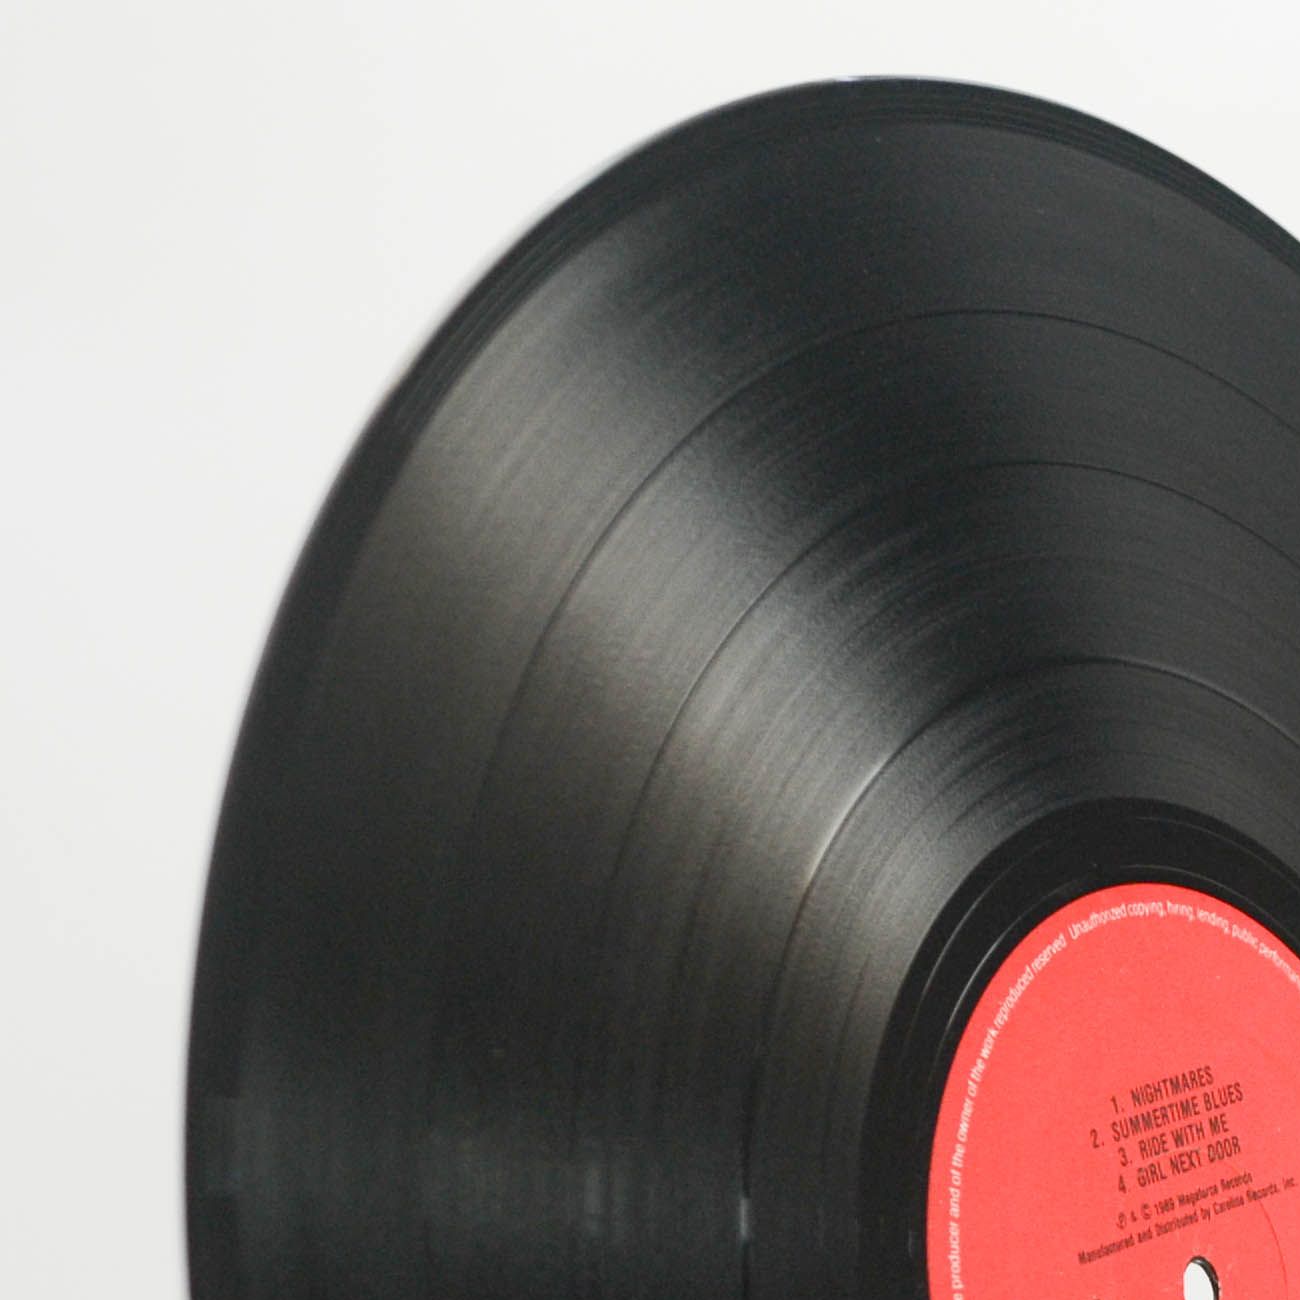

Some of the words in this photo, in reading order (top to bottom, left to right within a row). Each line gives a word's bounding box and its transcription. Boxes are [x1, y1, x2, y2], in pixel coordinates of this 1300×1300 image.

[1068, 902, 1127, 940] Unauthorized
[1031, 933, 1067, 973] reserved
[994, 964, 1034, 1029] reproduced
[981, 1027, 998, 1059] work
[967, 1079, 977, 1097] of
[970, 1059, 985, 1082] the
[1111, 1095, 1125, 1114] 1.
[1131, 1066, 1214, 1107] NIGHTMARES
[957, 1098, 974, 1142] owner
[1090, 1129, 1104, 1148] 2.
[1111, 1096, 1200, 1142] SUMMERTIME
[1203, 1082, 1244, 1112] BLUES
[952, 1144, 965, 1168] the
[1118, 1147, 1132, 1167] 3.
[1139, 1133, 1169, 1160] RIDE
[1171, 1120, 1205, 1148] WITH
[1209, 1113, 1229, 1136] ME
[951, 1169, 961, 1185] of
[1137, 1161, 1167, 1187] GIRL
[1170, 1149, 1201, 1175] NEXT
[1207, 1136, 1241, 1163] DOOR
[949, 1187, 960, 1218] and
[948, 1222, 964, 1289] producer
[1078, 1234, 1135, 1265] Manufactured
[1137, 1226, 1153, 1243] and
[1155, 1210, 1199, 1237] Distributed
[1200, 1208, 1211, 1222] by
